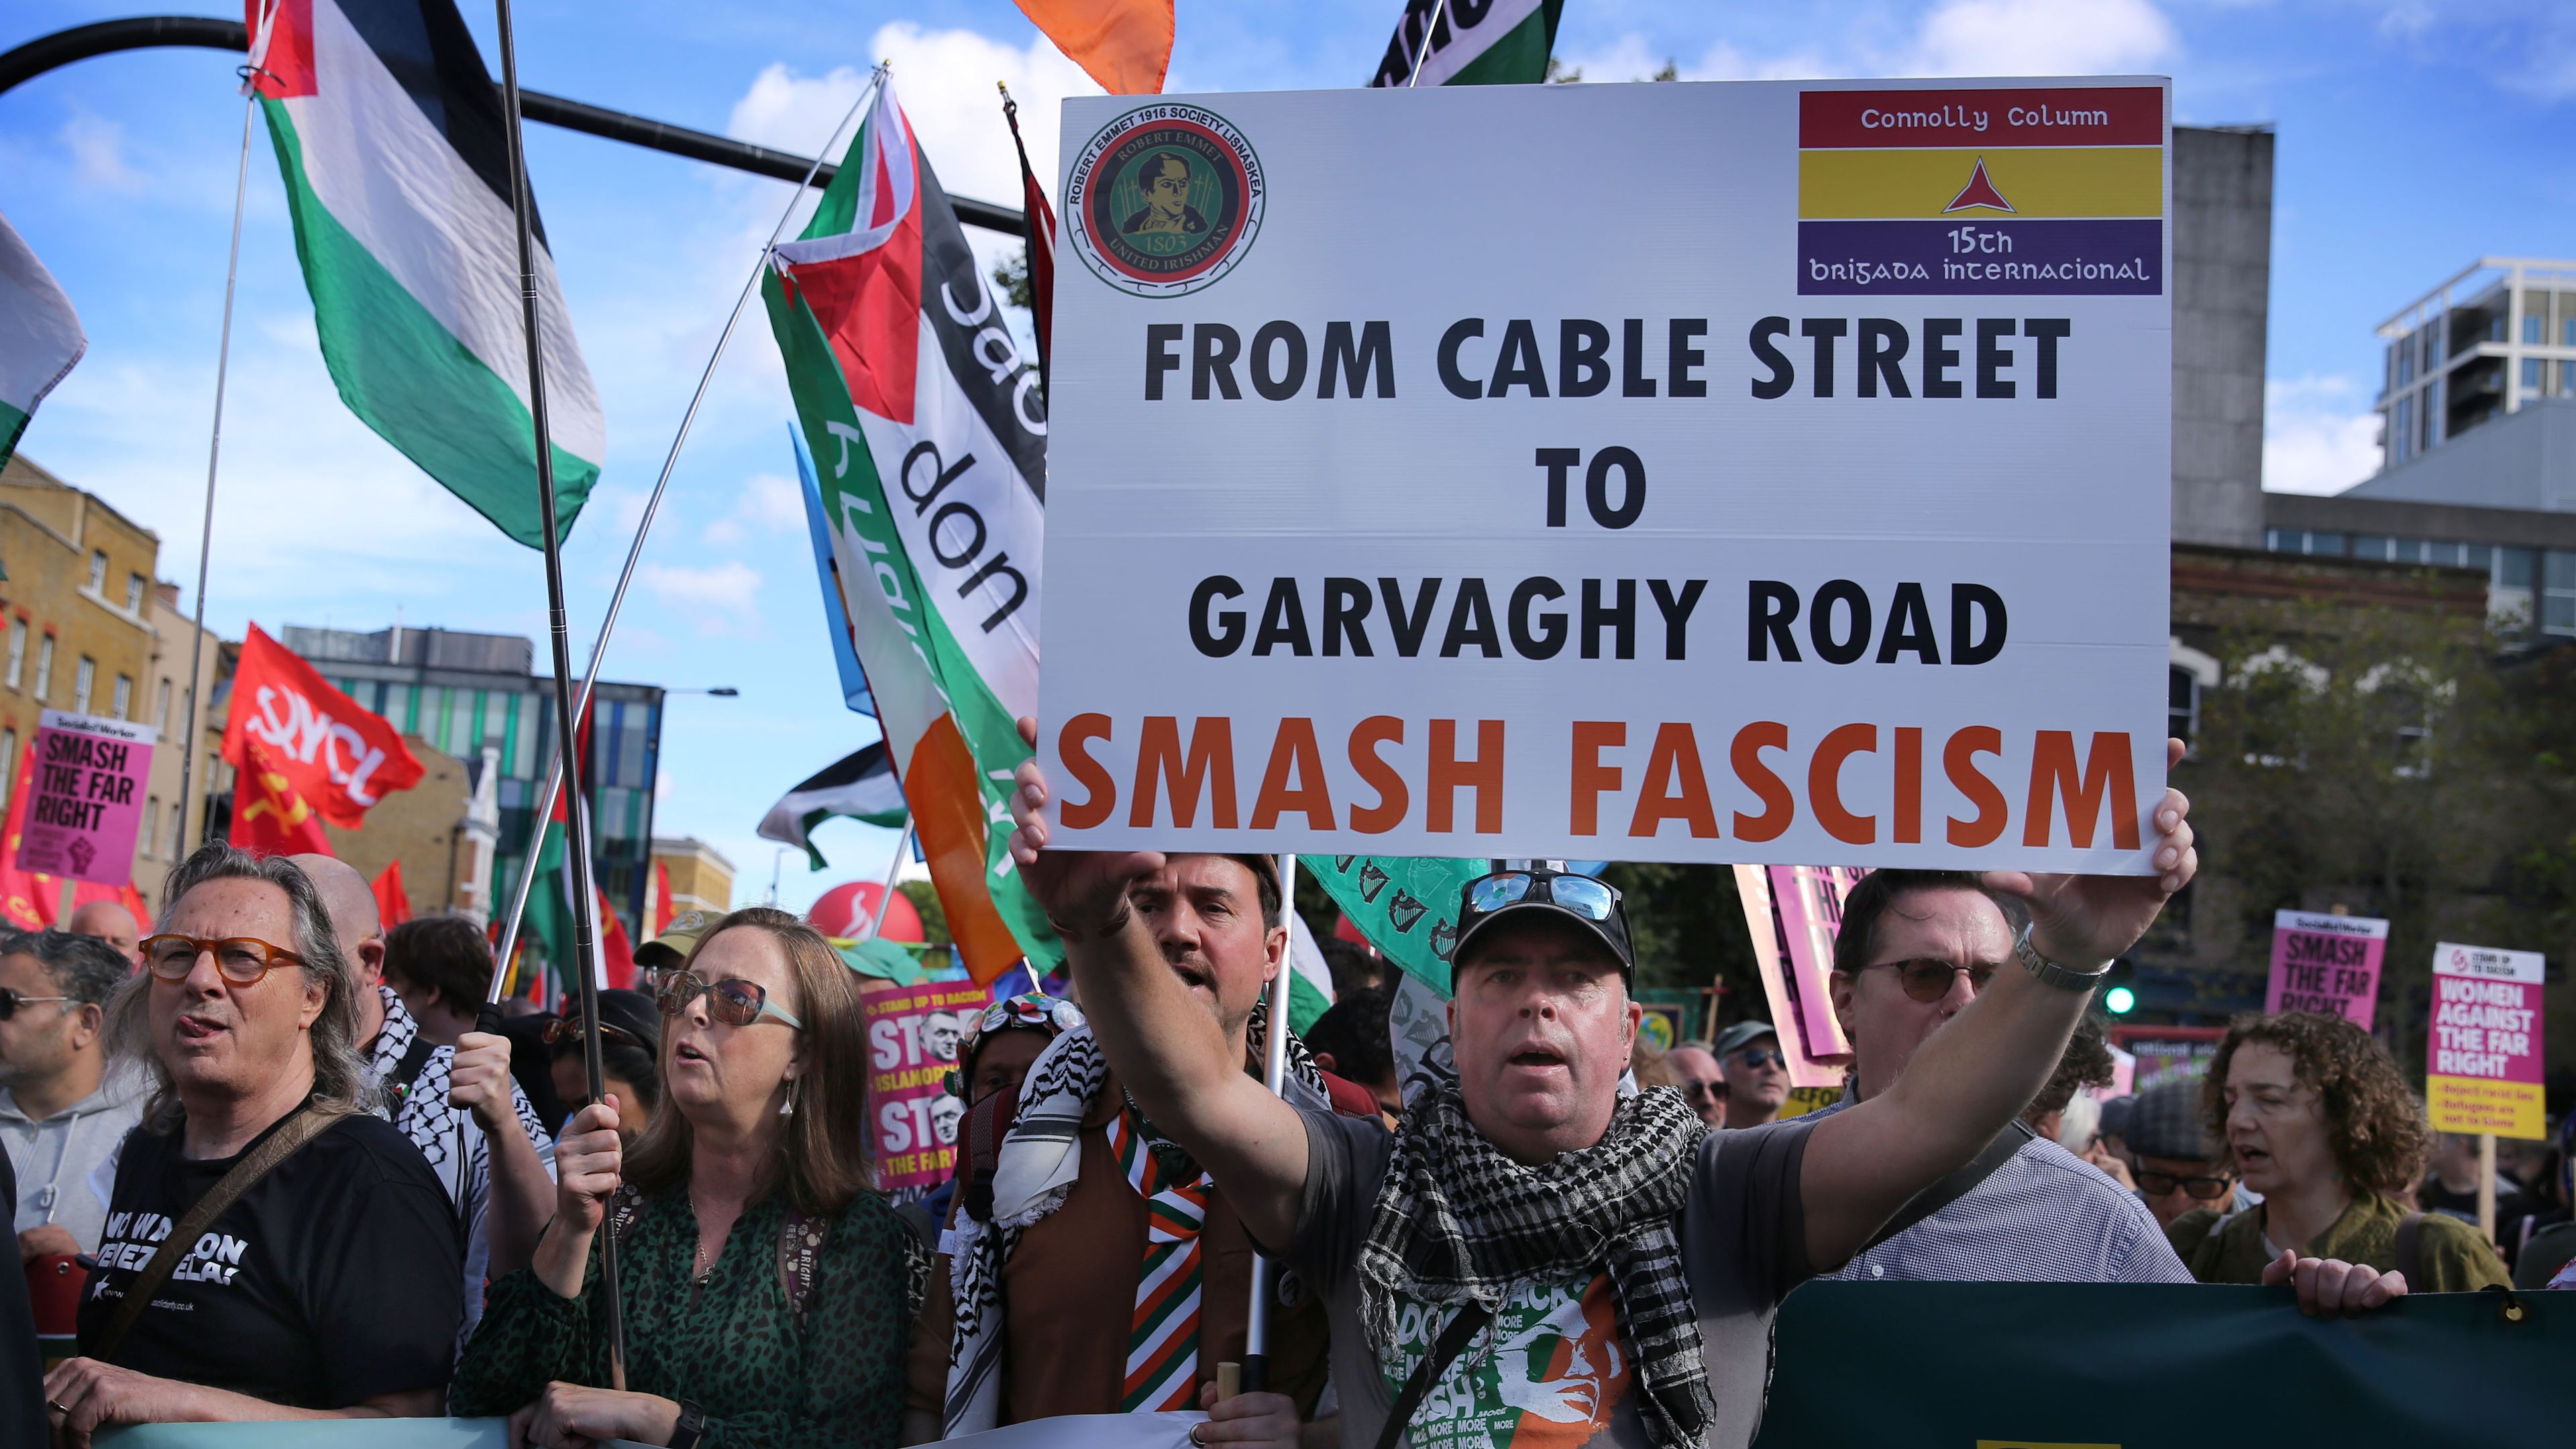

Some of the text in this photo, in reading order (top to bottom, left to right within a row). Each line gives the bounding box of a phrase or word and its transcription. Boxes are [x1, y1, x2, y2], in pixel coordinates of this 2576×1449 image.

[1861, 104, 2108, 131] Connolly Column
[1070, 107, 1262, 205] ROBERT EMMET 1916 SOCIETY LISNASKEA
[1118, 131, 1224, 162] ROBERT EMMET
[1110, 225, 1229, 271] UNITED IRISHMAN
[1145, 235, 1187, 252] 1803
[1947, 226, 2012, 254] 15th
[1146, 317, 2070, 400] FROM CABLE STREET
[1536, 447, 1646, 529] TO
[1189, 576, 2008, 665] GARVAGHY ROAD
[46, 733, 128, 771] SMASH
[42, 763, 134, 805] THE FAR
[1060, 714, 1505, 833] SMASH
[1570, 722, 2140, 849] FASCISM
[35, 794, 106, 831] RIGHT
[2286, 933, 2368, 967] SMASH
[2284, 963, 2372, 997] THE FAR
[2439, 976, 2524, 1009] WOMEN
[913, 996, 929, 1008] UP
[2436, 1001, 2536, 1034] AGAINST
[2435, 1024, 2530, 1057] THE FAR
[2436, 1049, 2510, 1079] RIGHT
[887, 1154, 917, 1177] THE
[919, 1148, 952, 1172] FAR
[131, 1212, 173, 1242] WA
[194, 1232, 249, 1266] ON
[97, 1241, 240, 1287] VENEZELA!
[800, 1249, 812, 1288] BRIGHT
[1428, 1421, 1454, 1438] MORE
[1457, 1417, 1487, 1434] MORE
[1494, 1419, 1514, 1430] MORE
[1477, 1407, 1508, 1417] MORE
